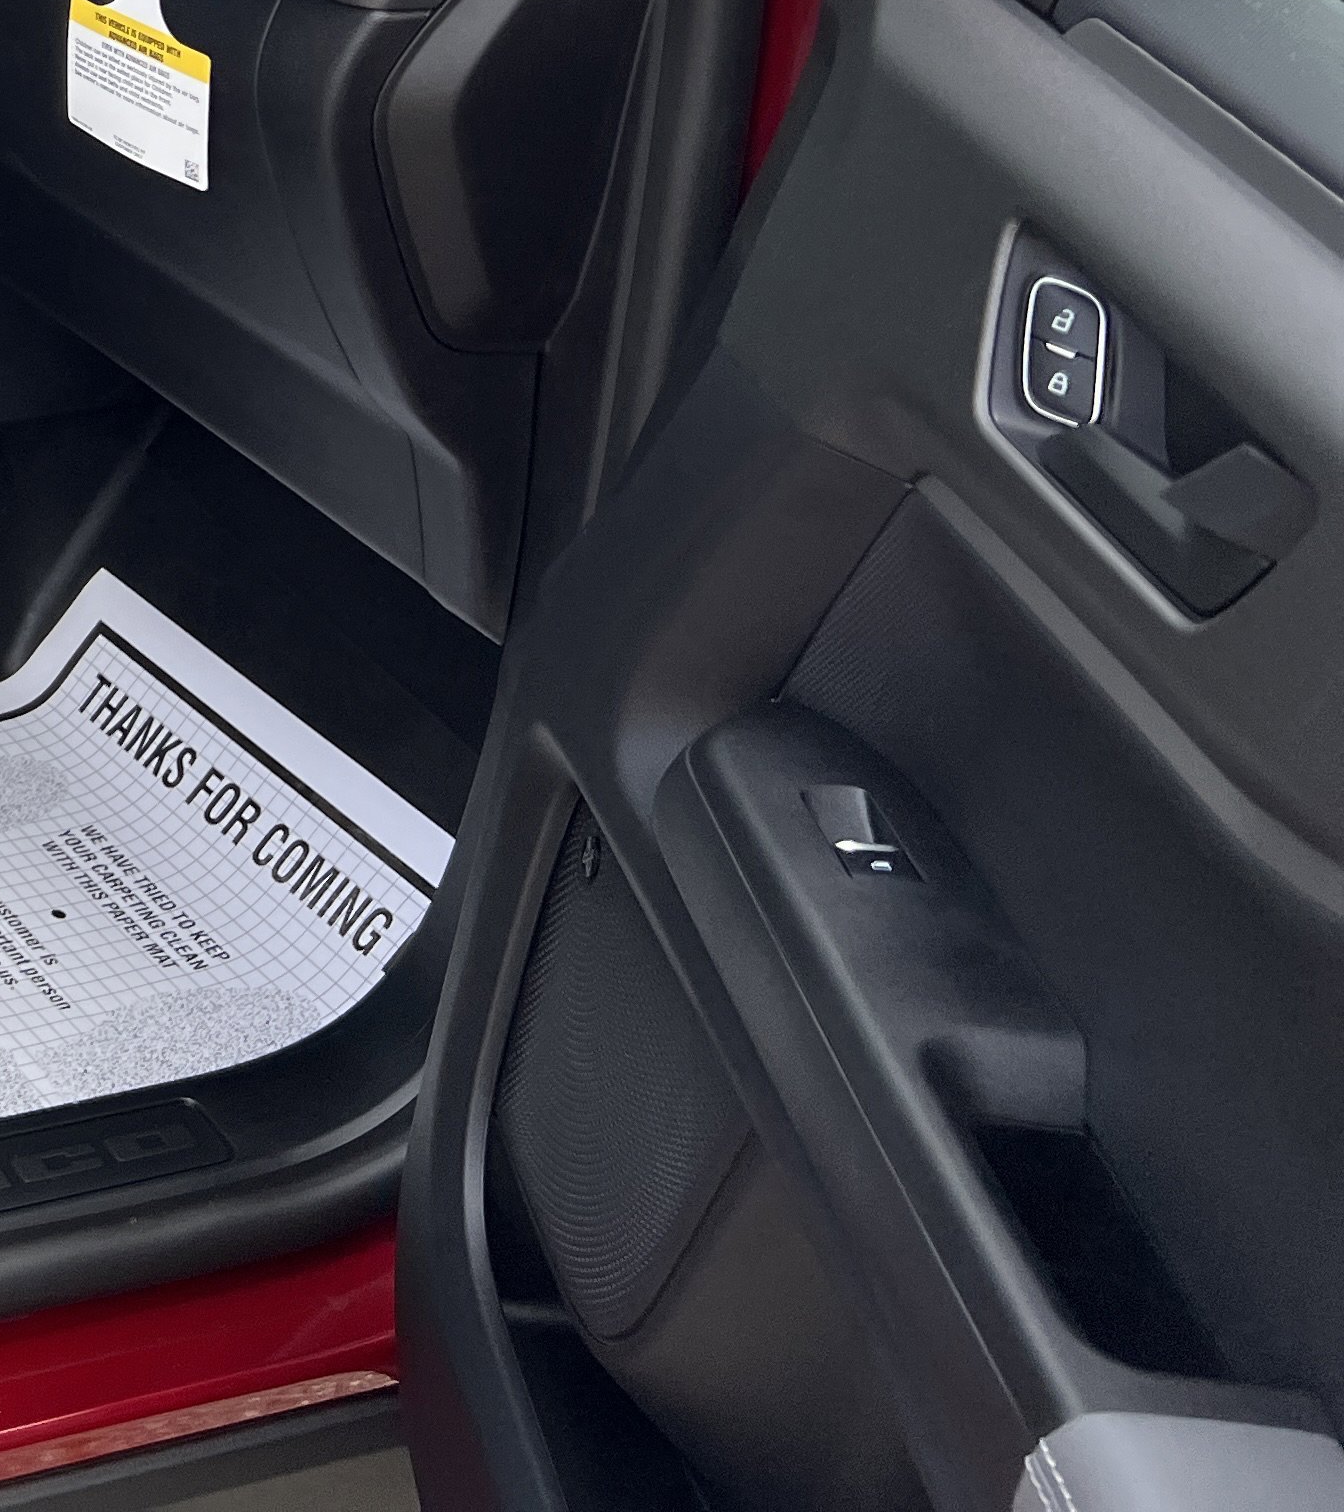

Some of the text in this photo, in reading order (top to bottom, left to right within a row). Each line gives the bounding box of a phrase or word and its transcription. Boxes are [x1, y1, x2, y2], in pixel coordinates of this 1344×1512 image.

[96, 12, 180, 59] THIS VEHICLE IS EQUIPPED WITH
[78, 674, 393, 956] THANKS FOR COMING
[42, 840, 180, 969] WITH THIS PAPER MAT
[58, 830, 209, 971] YOUR CARPETING CLEAN
[81, 824, 230, 961] WE HAVE TRIED TO KEEP
[19, 967, 71, 1010] person
[40, 953, 58, 966] is
